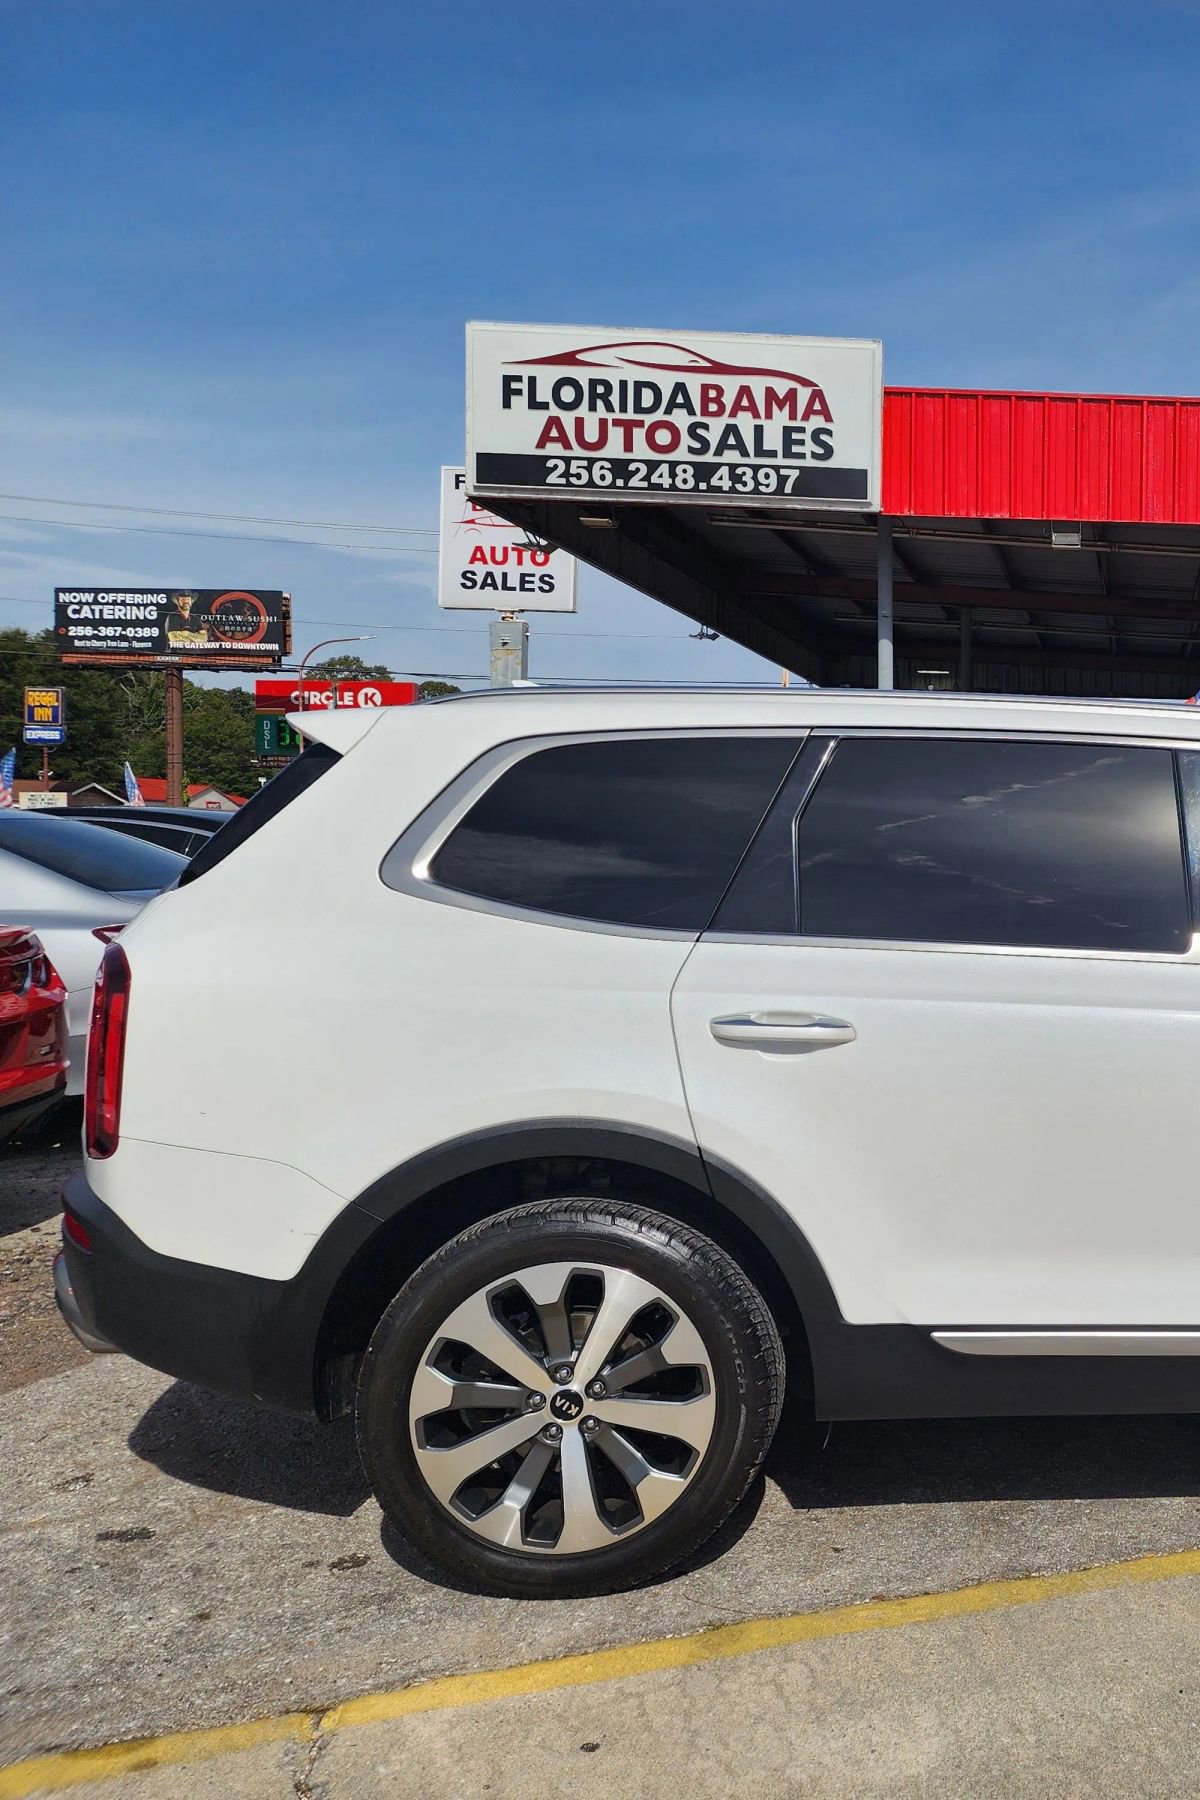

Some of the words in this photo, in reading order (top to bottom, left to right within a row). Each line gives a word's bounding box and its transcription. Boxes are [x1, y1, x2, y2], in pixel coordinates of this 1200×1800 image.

[545, 457, 800, 495] 256.248.4397
[467, 545, 550, 568] AUTO
[460, 570, 556, 594] SALES
[58, 592, 95, 603] NOW
[97, 593, 168, 605] OFFERING
[67, 604, 158, 620] CATERING
[200, 614, 244, 622] OUTLAW
[247, 615, 279, 623] SUSHI
[67, 626, 160, 637] 256-367-0389
[168, 641, 184, 649] THE
[184, 642, 220, 650] GATEWAY
[221, 642, 231, 650] TO
[232, 642, 279, 651] DOWNTOWN
[28, 691, 59, 707] REGAL
[290, 691, 355, 706] CIRCLE
[34, 706, 52, 721] INN
[263, 720, 271, 749] DSL
[554, 1395, 580, 1416] KIA
